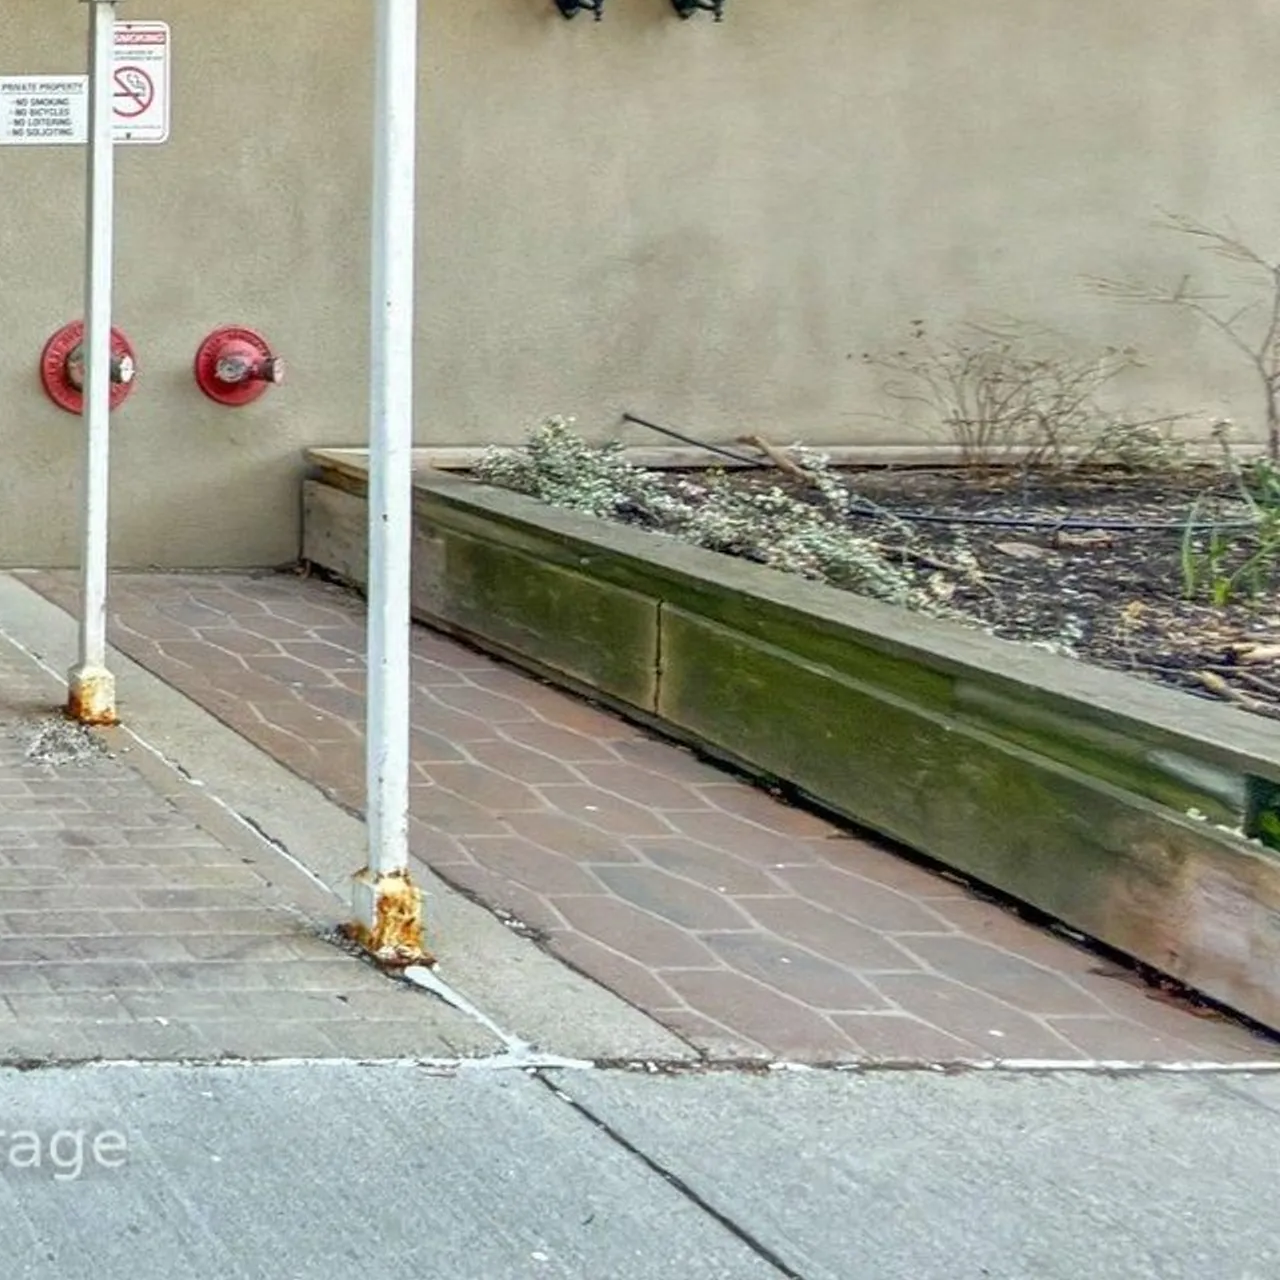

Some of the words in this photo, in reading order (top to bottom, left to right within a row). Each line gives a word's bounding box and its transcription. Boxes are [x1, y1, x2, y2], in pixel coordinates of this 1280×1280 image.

[2, 83, 37, 92] PRIVATE
[39, 82, 84, 92] PROPERTY
[30, 98, 70, 107] SMOKING
[30, 108, 70, 117] BICYCLES
[28, 118, 73, 127] LOITERING
